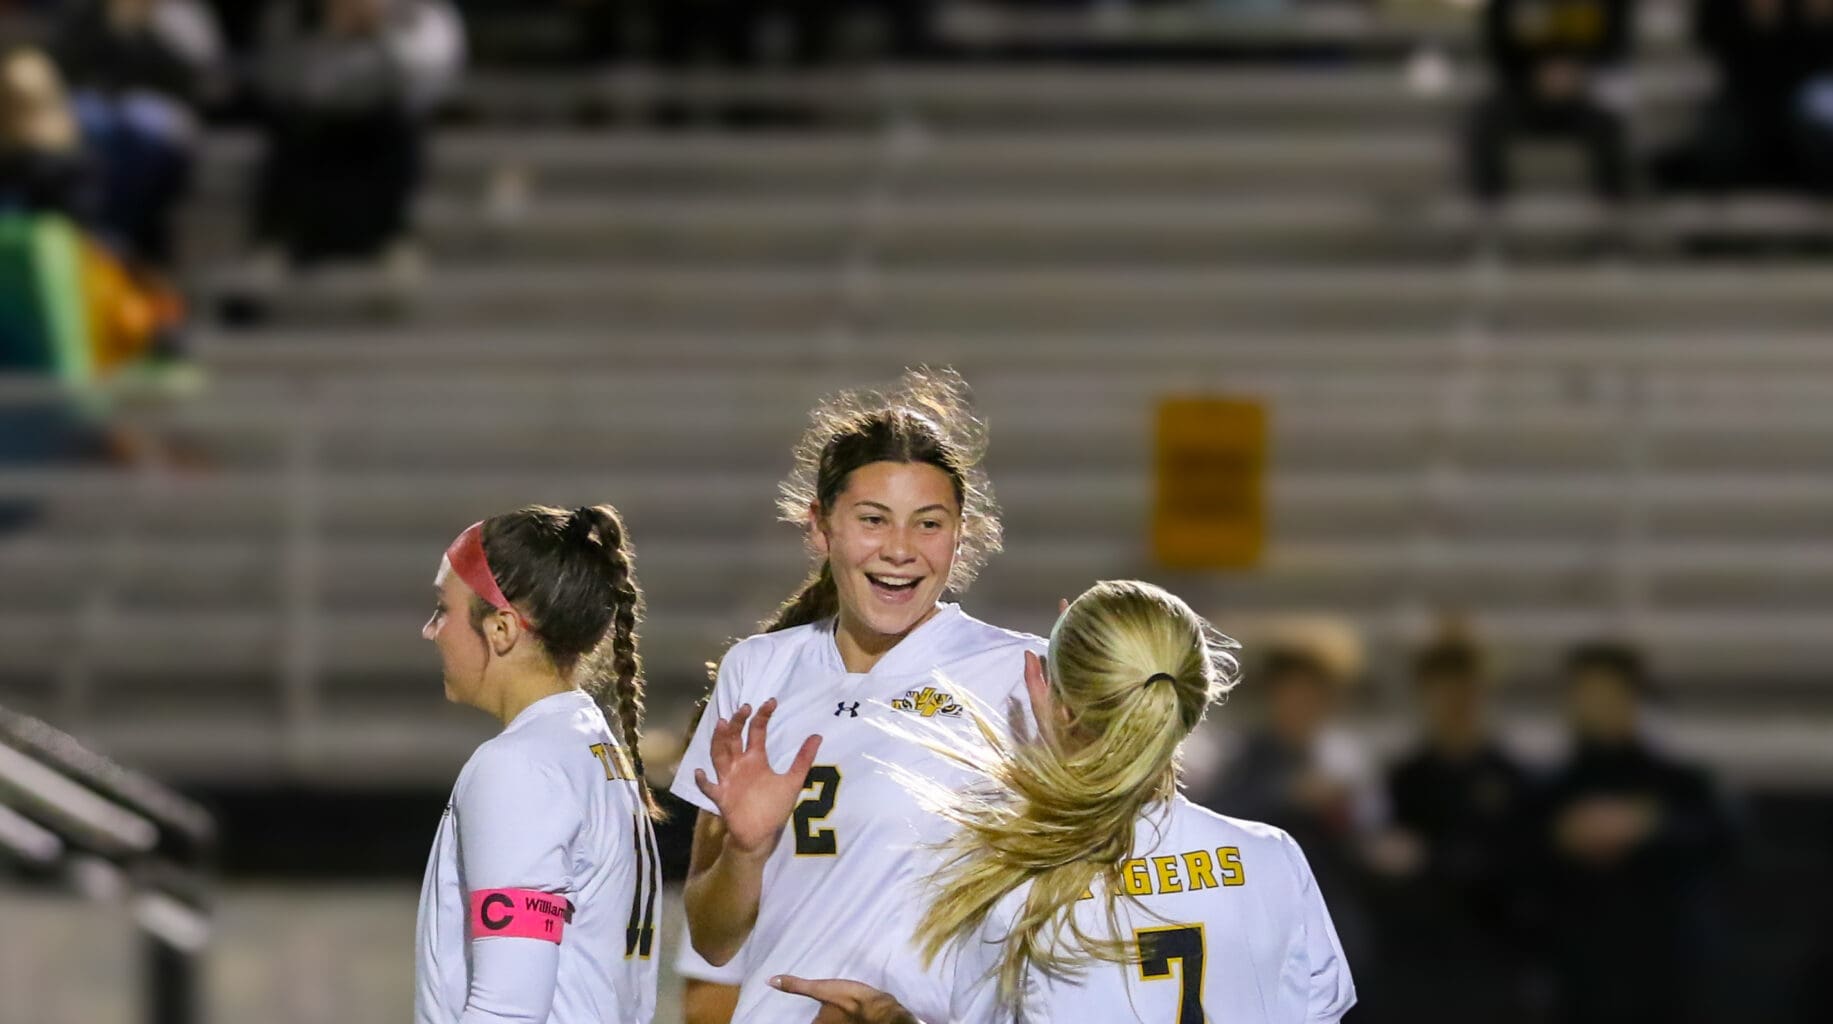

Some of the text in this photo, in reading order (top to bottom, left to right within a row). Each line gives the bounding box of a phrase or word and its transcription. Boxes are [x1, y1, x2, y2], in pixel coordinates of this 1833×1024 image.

[793, 763, 842, 858] 2
[1076, 846, 1245, 901] GERS
[480, 893, 515, 930] C
